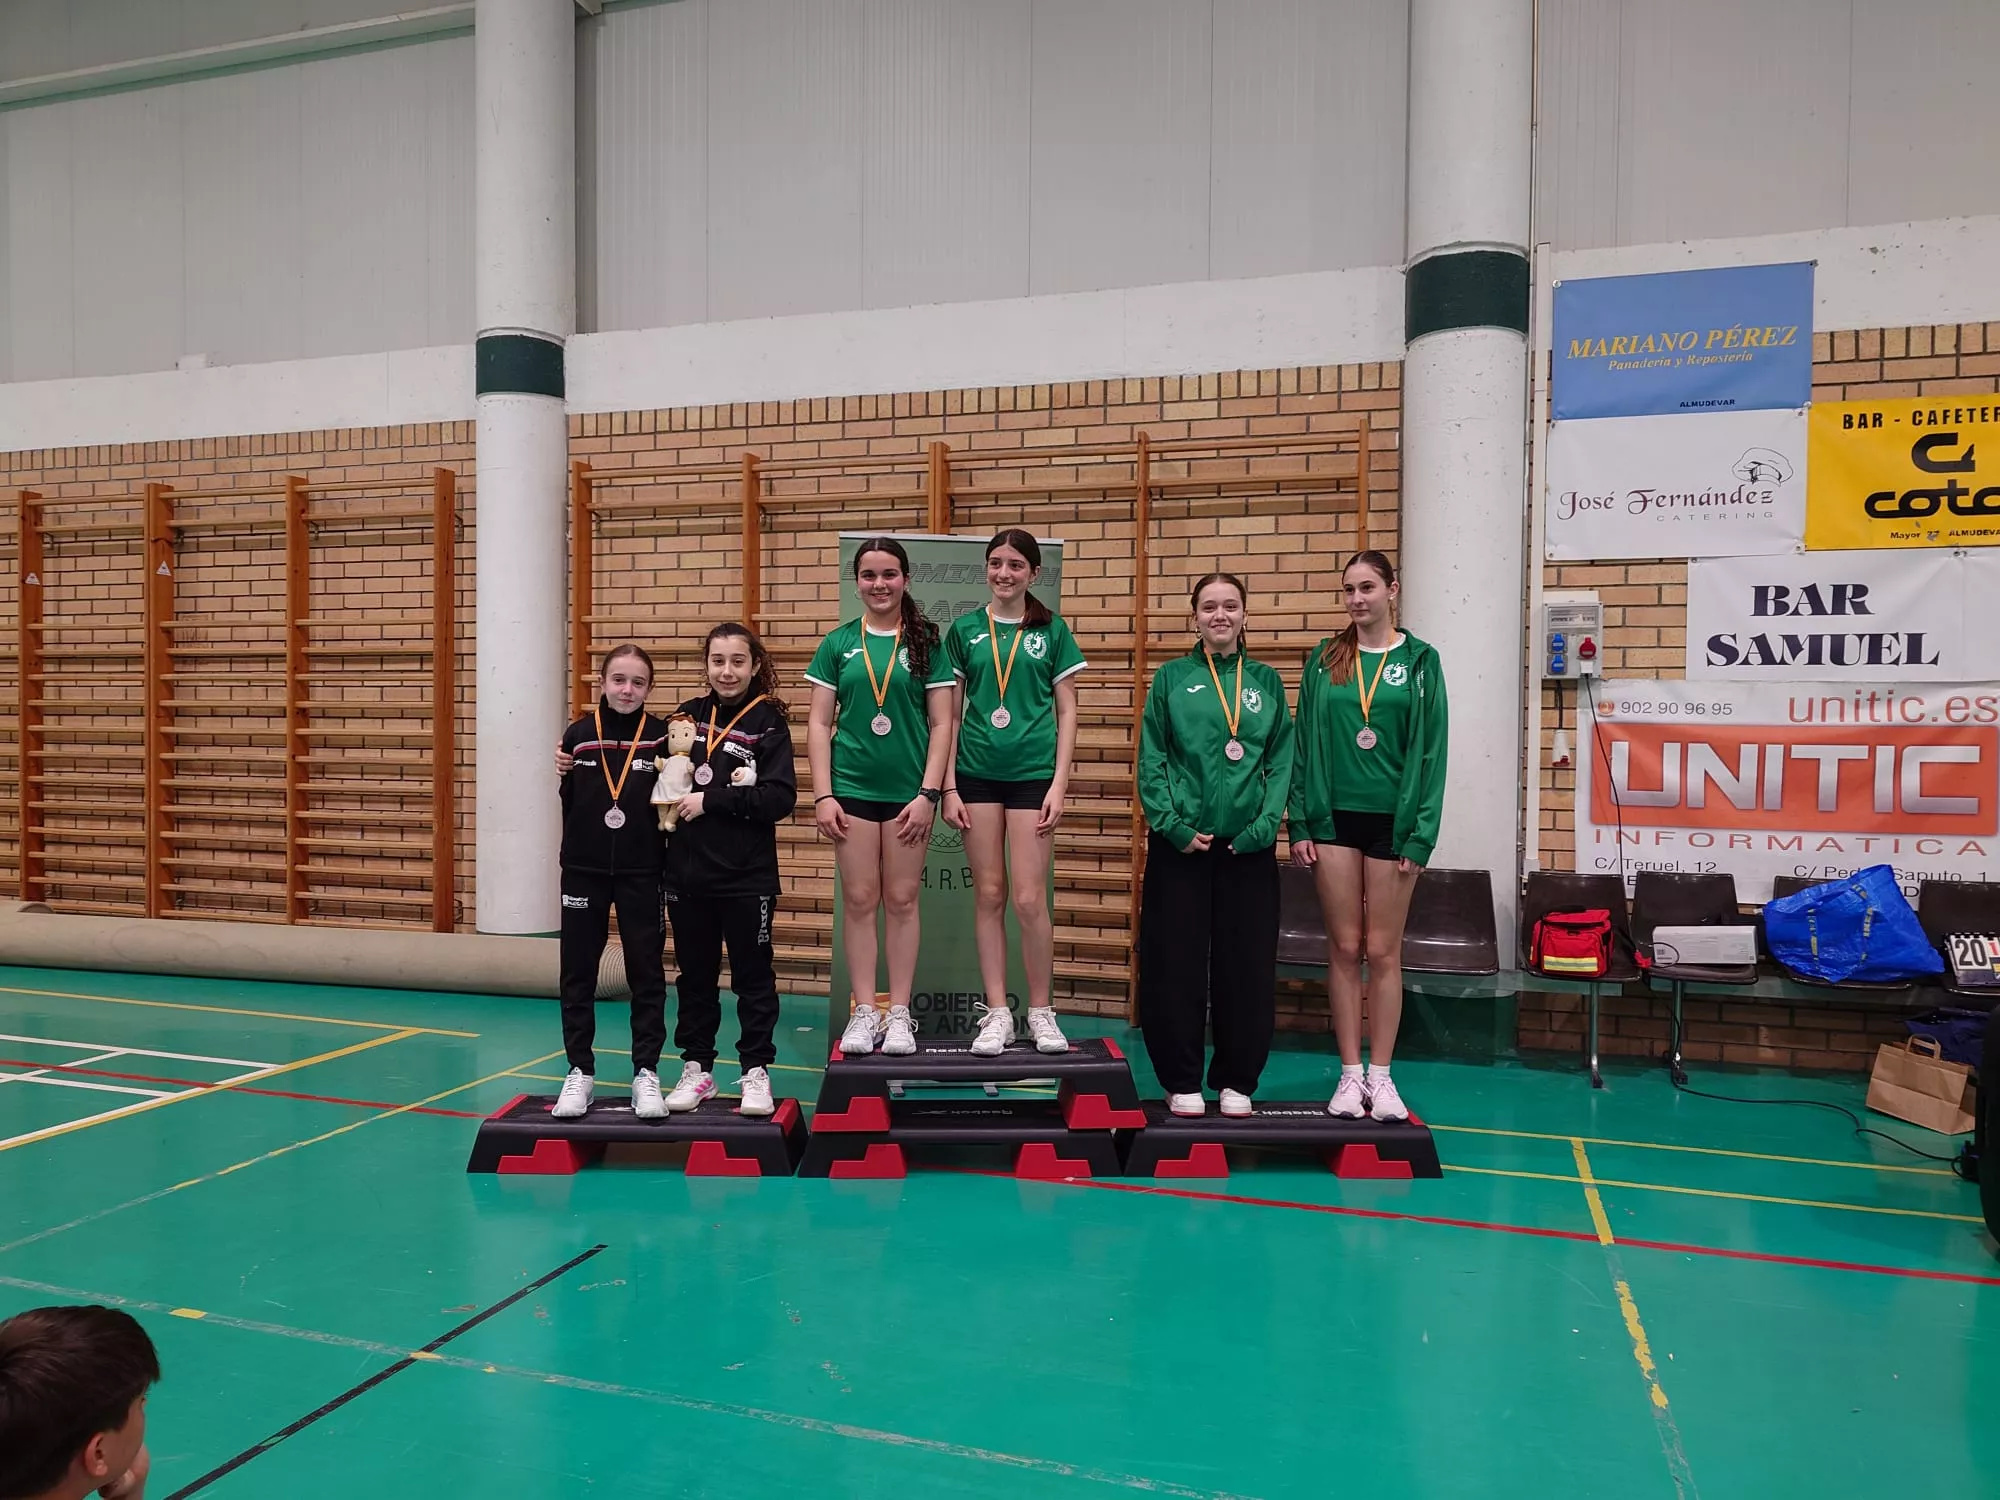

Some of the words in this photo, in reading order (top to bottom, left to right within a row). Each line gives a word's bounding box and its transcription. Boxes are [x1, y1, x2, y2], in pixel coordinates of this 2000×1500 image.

[1567, 330, 1698, 359] MARIANO
[1704, 323, 1798, 350] PÉREZ
[1674, 358, 1683, 368] y
[1687, 350, 1753, 367] Repostería
[1679, 398, 1736, 408] ALMUDEVAR
[1842, 412, 1883, 430] BAR
[1556, 490, 1615, 521] José
[1626, 484, 1773, 515] Fernández
[1656, 511, 1774, 522] CATERING
[1890, 531, 1921, 540] Mayor
[1749, 582, 1875, 617] BAR
[1706, 632, 1940, 667] SAMUEL
[1621, 701, 1652, 714] 902
[1658, 702, 1679, 715] 90
[1684, 702, 1706, 715] 96
[1711, 703, 1733, 716] 95
[1788, 689, 1999, 723] unitic.es
[1610, 740, 1981, 815] UNITIC
[1595, 828, 1987, 857] INFORMATICA
[1594, 857, 1616, 870] C/
[1694, 861, 1717, 873] 12
[1794, 864, 1816, 879] C/
[1955, 938, 1988, 967] 20
